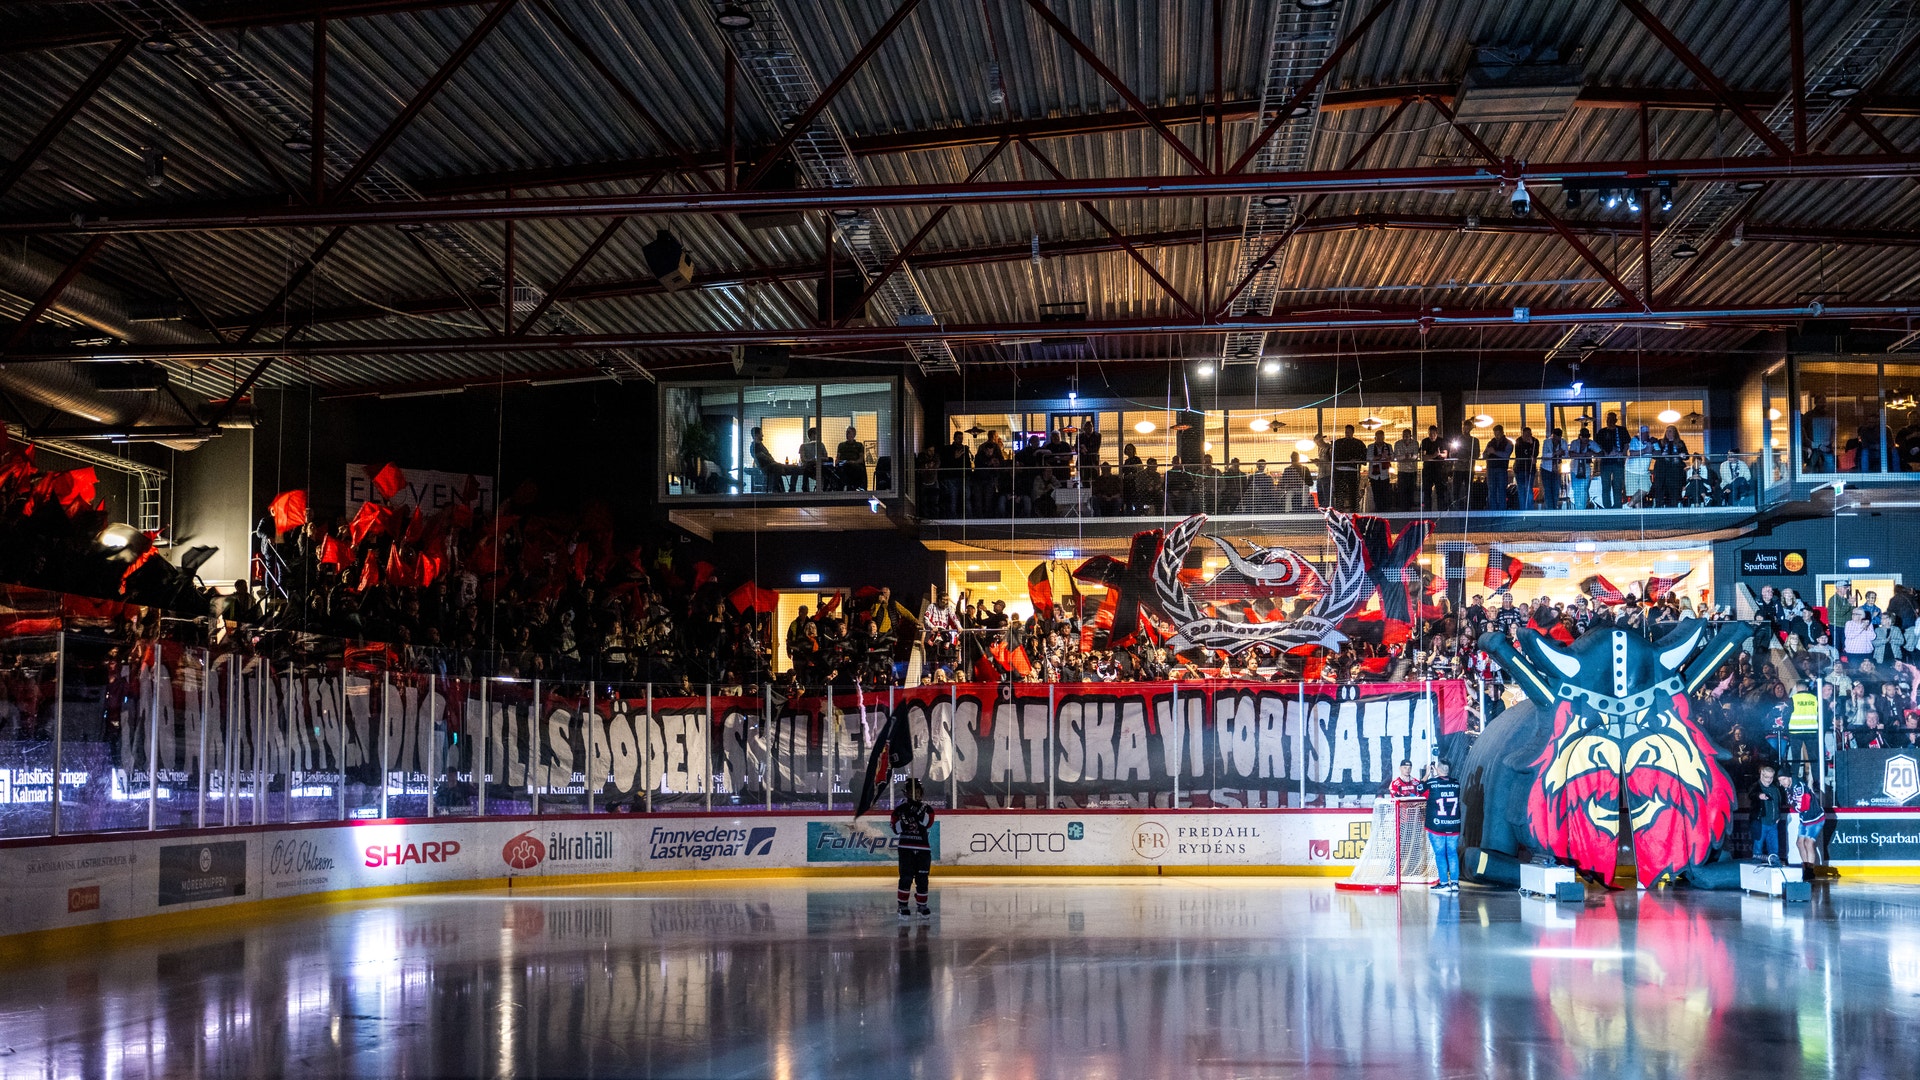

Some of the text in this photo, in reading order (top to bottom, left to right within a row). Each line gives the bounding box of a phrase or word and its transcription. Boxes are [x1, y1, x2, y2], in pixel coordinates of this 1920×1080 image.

[1755, 552, 1777, 562] Ålems
[1744, 562, 1777, 571] Sparbank
[466, 697, 574, 789] TILLS
[581, 698, 709, 793] DÖDEN
[905, 700, 979, 784] OSS
[989, 685, 1049, 784] ÅT
[1057, 699, 1151, 783] SKA
[1157, 697, 1203, 780] VI
[1215, 683, 1440, 785] FORTSÄTTA
[1890, 767, 1912, 788] 20
[47, 785, 63, 802] ln
[1435, 797, 1459, 816] 17
[649, 826, 747, 844] Finnvedens
[1178, 827, 1260, 838] FREDAHL
[1831, 830, 1868, 844] Ålems
[549, 831, 613, 861] åkrahäll
[650, 843, 744, 861] Lastvagnar
[969, 829, 1065, 859] axipto
[1178, 840, 1246, 854] RYDÉNS
[364, 840, 461, 868] SHARP
